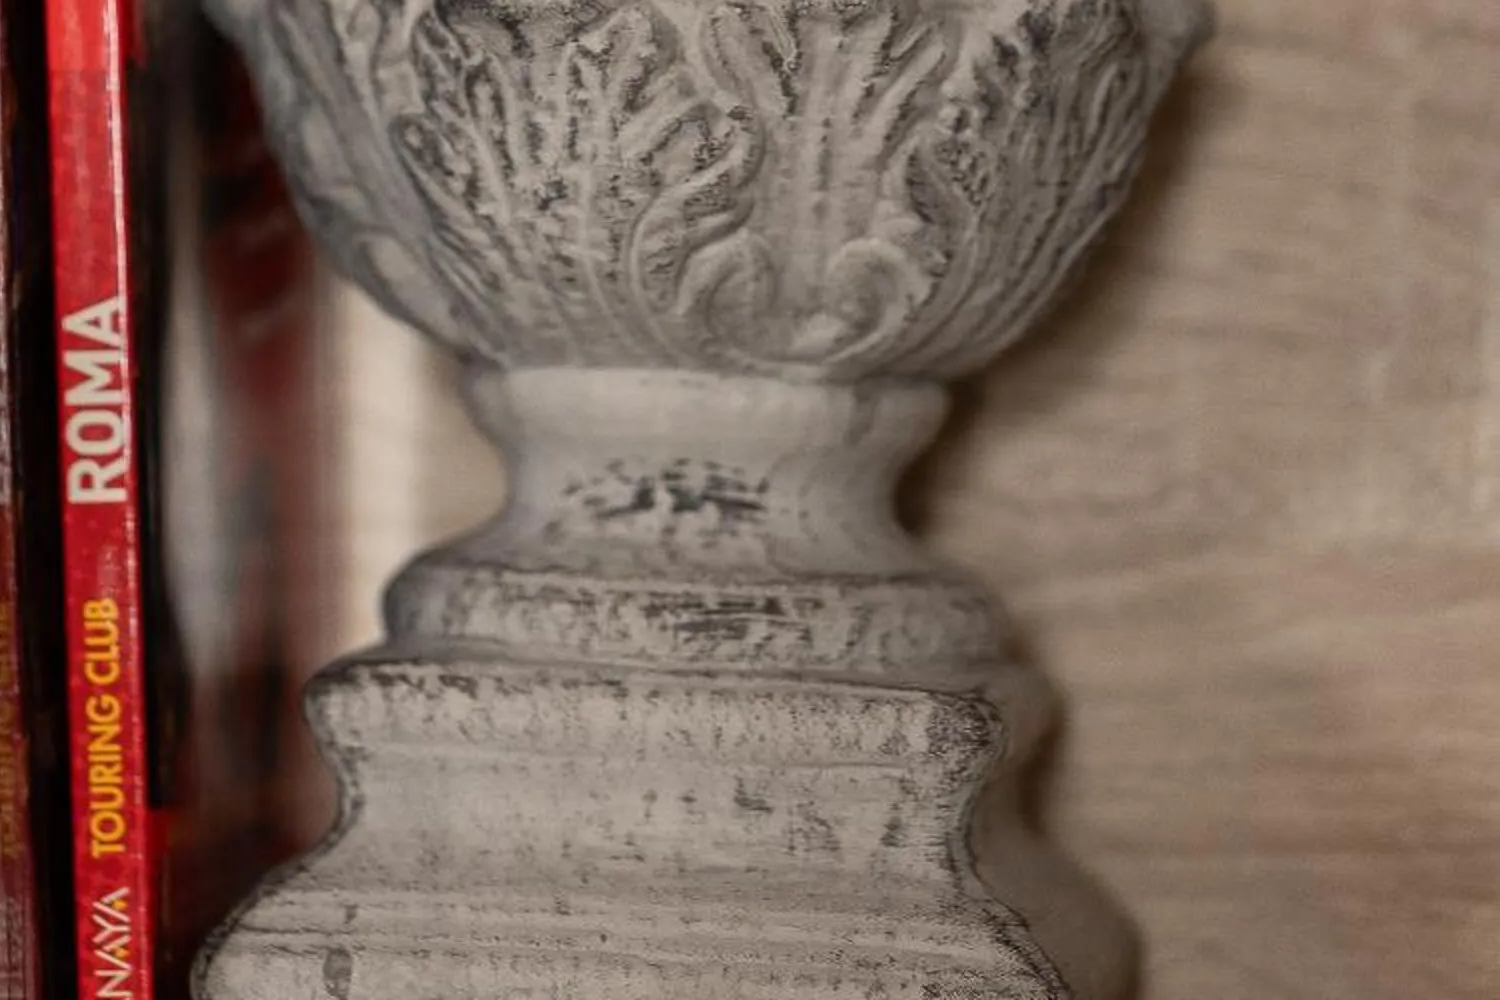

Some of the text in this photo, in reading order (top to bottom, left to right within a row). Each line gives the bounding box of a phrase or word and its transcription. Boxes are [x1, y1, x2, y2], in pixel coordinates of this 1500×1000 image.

[61, 295, 131, 505] ROMA
[83, 597, 127, 860] TOURING CLUB
